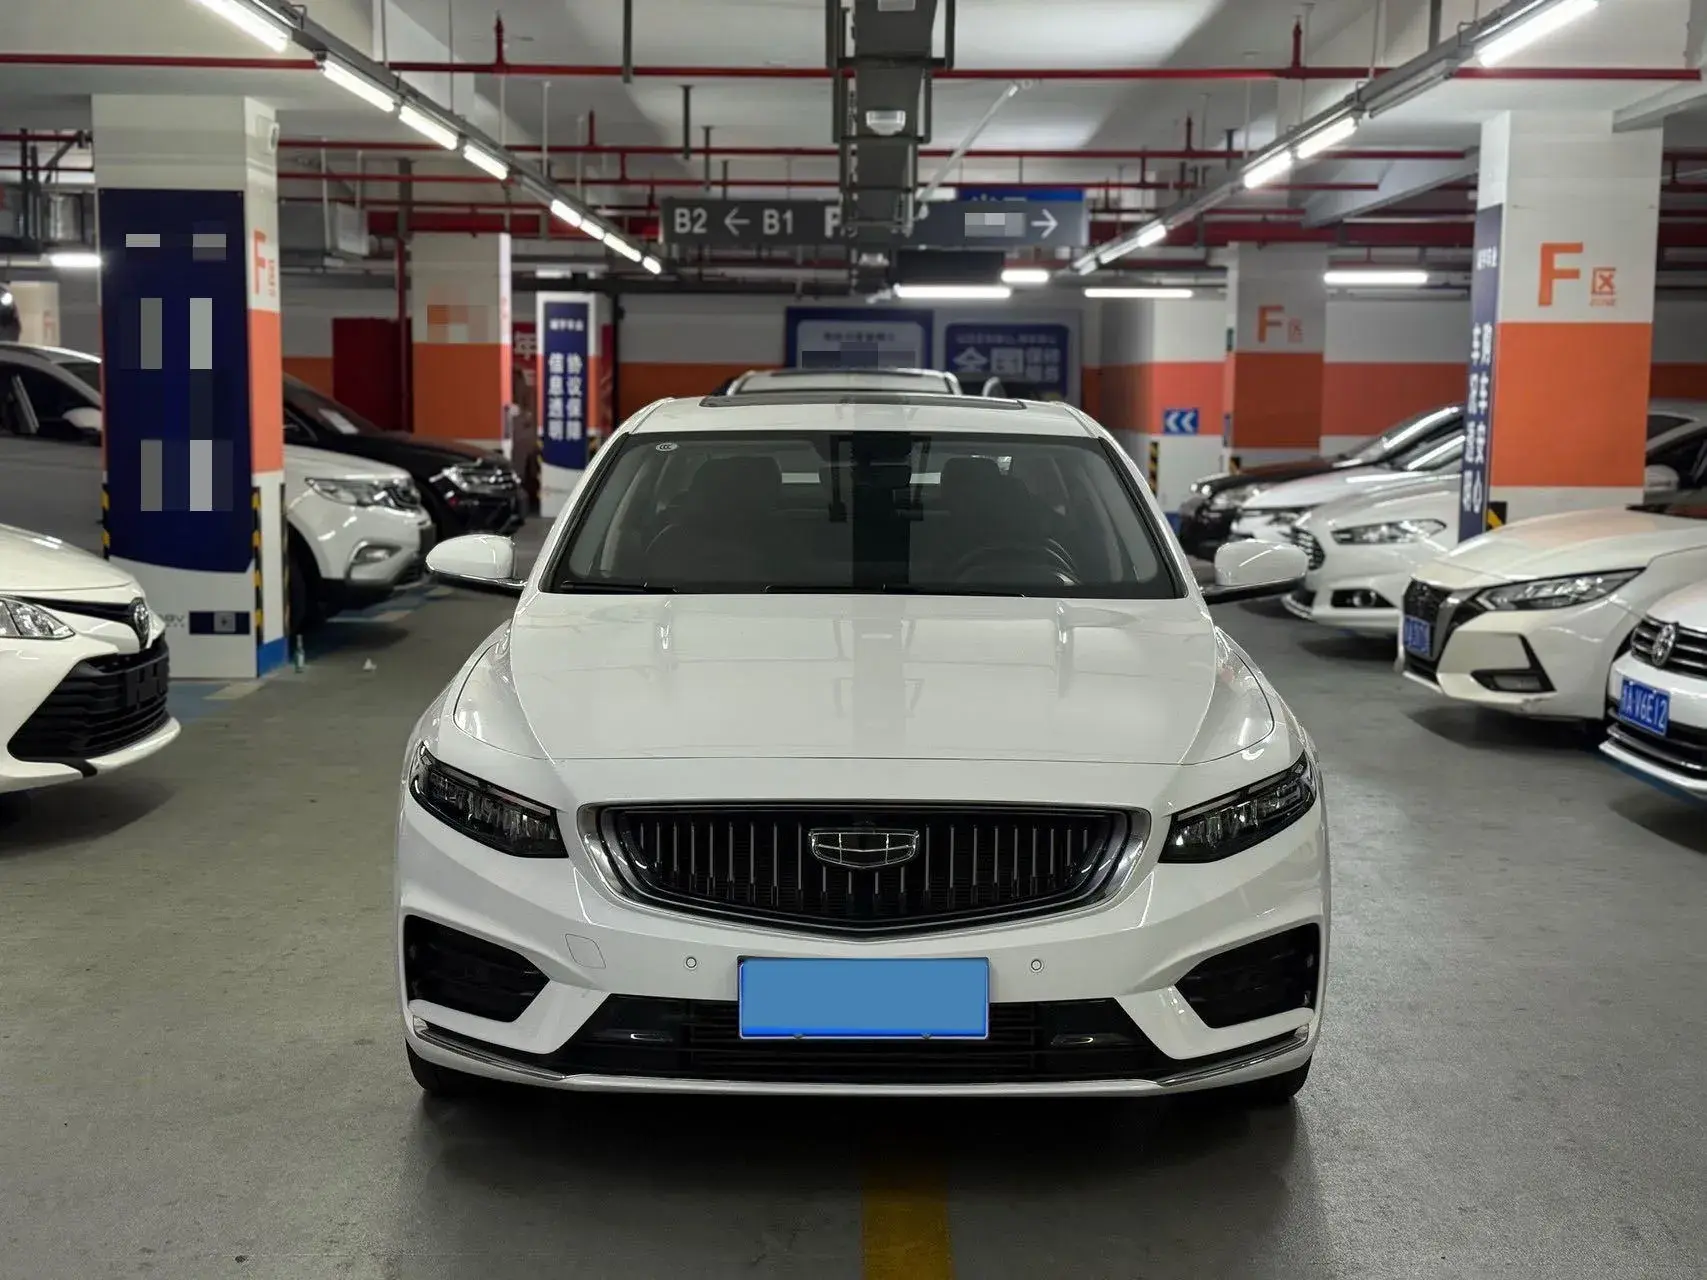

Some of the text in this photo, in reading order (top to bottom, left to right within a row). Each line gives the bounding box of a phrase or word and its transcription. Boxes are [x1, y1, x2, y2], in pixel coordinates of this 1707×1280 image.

[674, 207, 708, 234] B2
[762, 208, 794, 235] B1
[1538, 241, 1584, 307] F
[1590, 266, 1617, 295] 区
[1257, 304, 1285, 343] F
